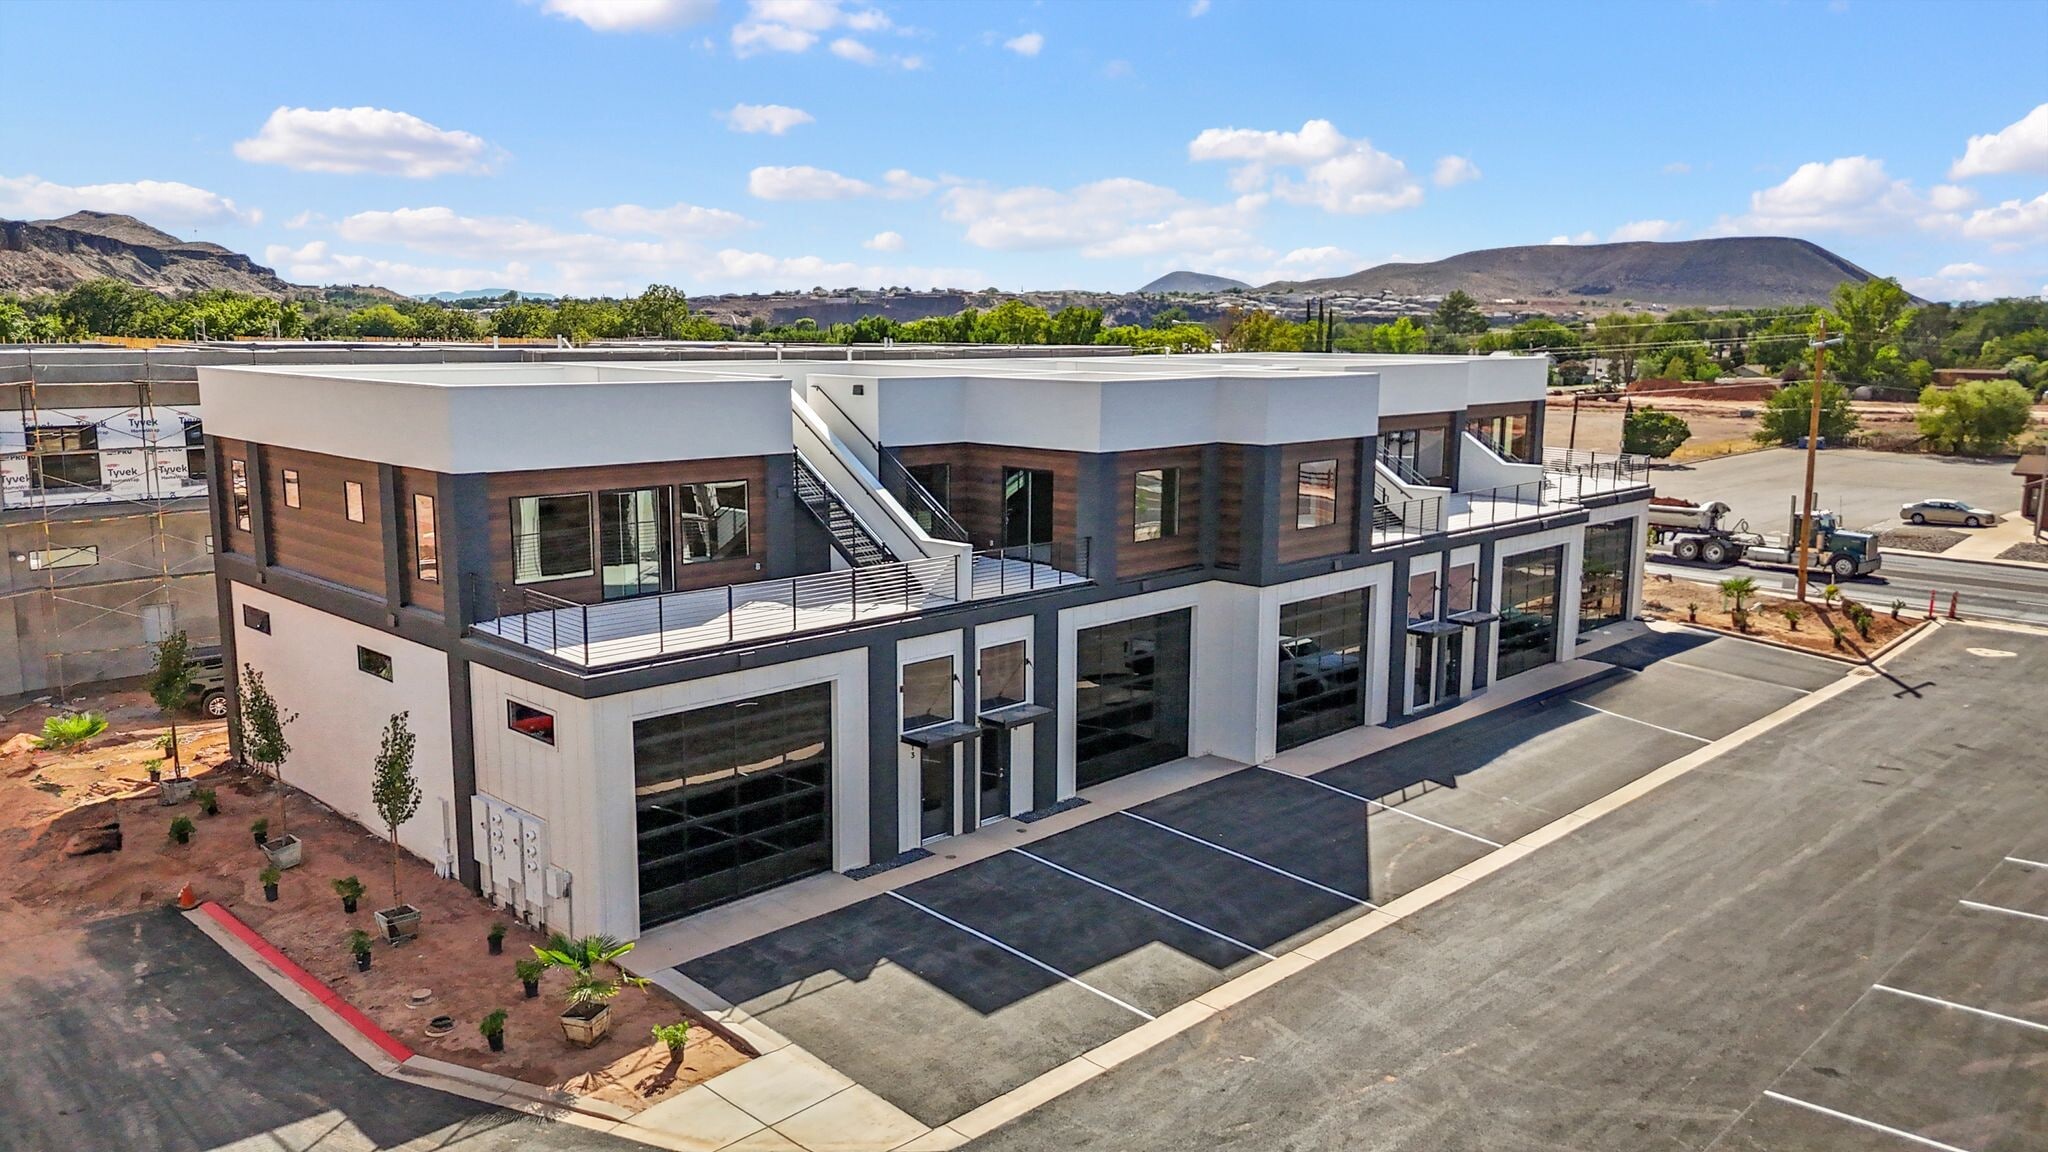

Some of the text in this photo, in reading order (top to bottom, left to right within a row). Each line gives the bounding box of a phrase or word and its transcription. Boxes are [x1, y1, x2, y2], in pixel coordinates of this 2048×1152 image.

[128, 418, 158, 428] Tyvek
[107, 467, 138, 479] Tyvek
[159, 464, 188, 475] Tyvek
